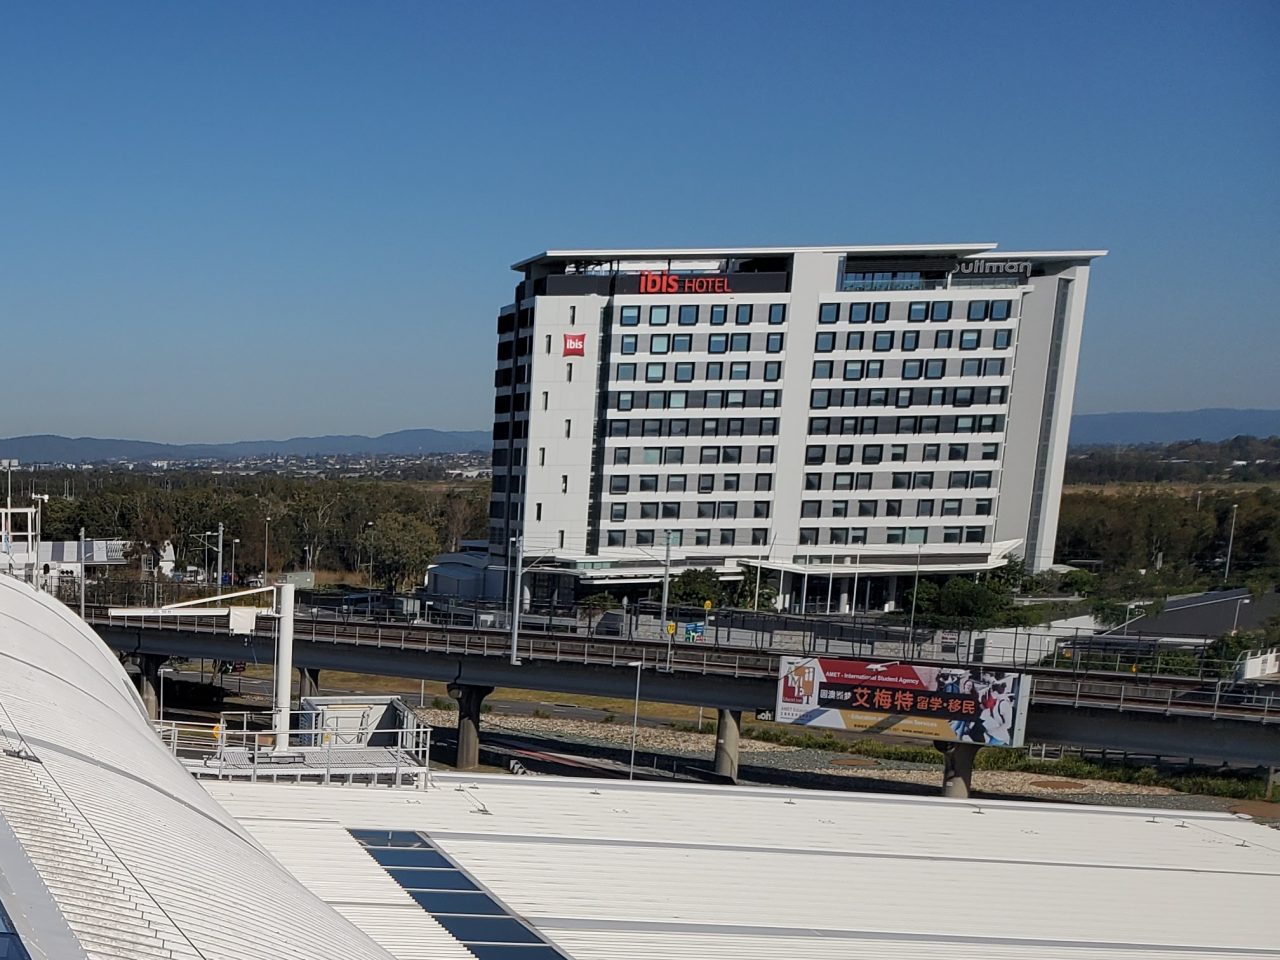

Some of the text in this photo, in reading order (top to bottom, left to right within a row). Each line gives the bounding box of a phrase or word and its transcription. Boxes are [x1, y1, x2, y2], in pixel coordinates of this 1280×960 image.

[639, 270, 732, 293] ibis HOTEL
[566, 338, 583, 349] ibis
[843, 673, 877, 681] International
[898, 676, 920, 685] Agency
[852, 687, 914, 711] 艾梅特
